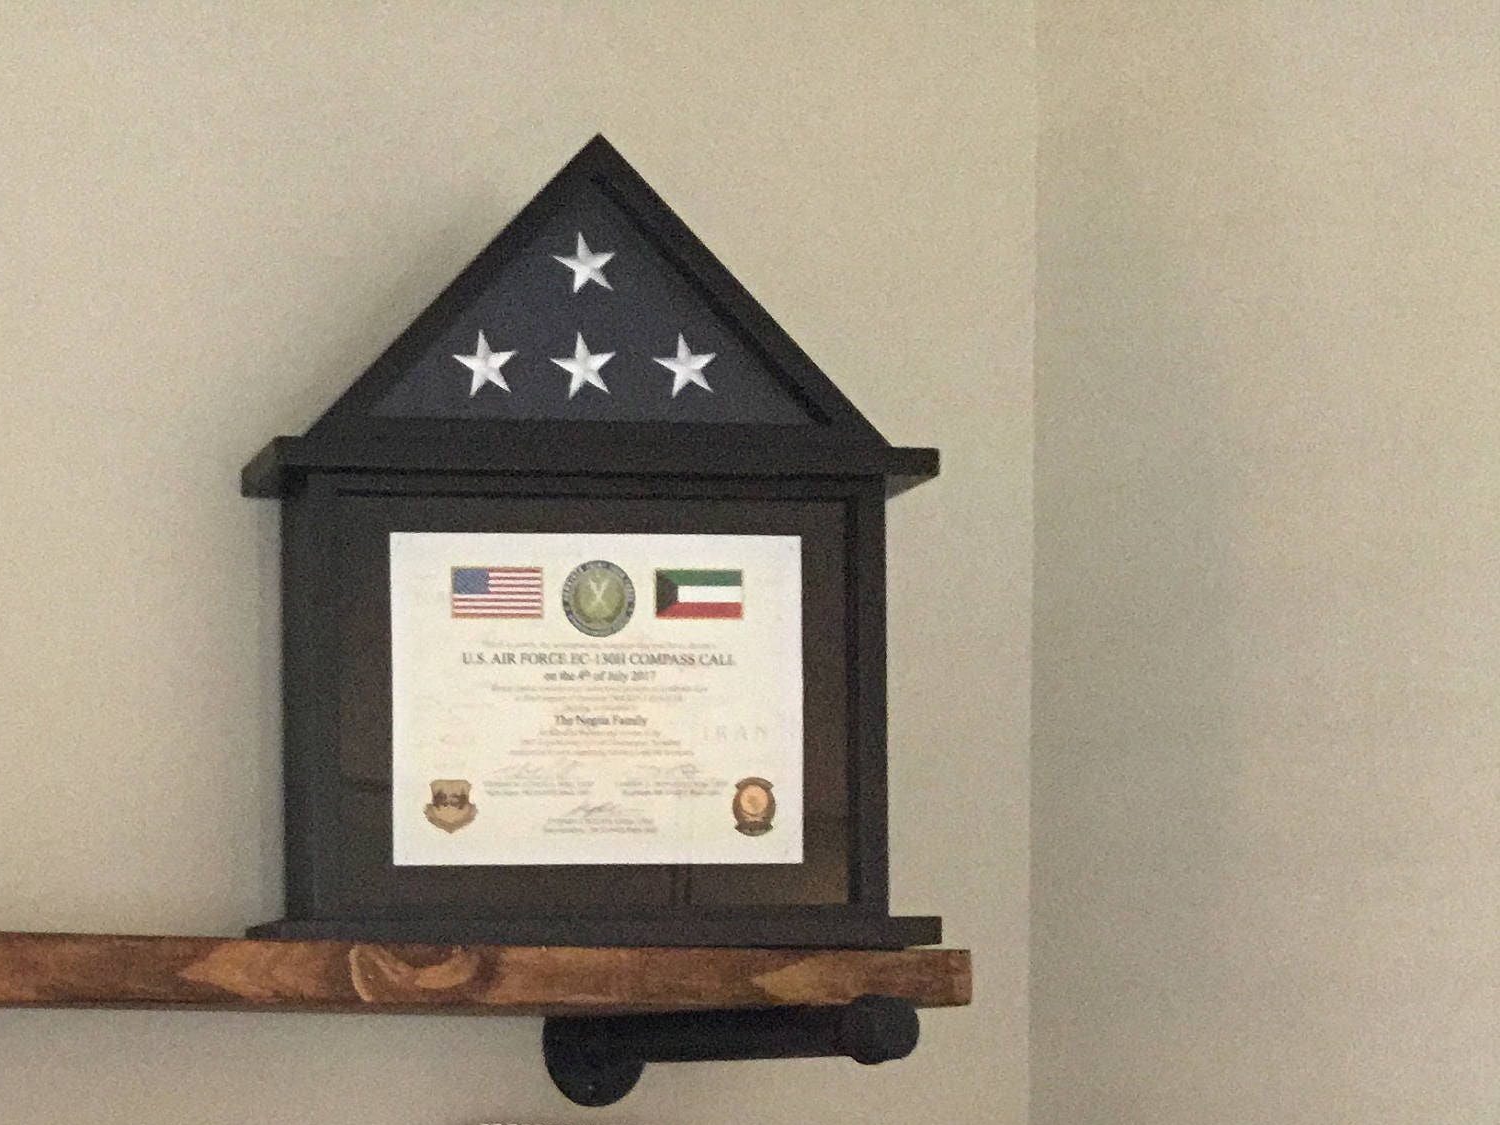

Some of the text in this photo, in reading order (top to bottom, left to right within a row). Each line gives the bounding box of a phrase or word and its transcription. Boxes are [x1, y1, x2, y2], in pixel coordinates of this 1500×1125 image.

[491, 652, 517, 665] AIR
[520, 652, 566, 665] FORCE
[629, 652, 696, 666] COMPASS
[699, 653, 735, 666] CALL
